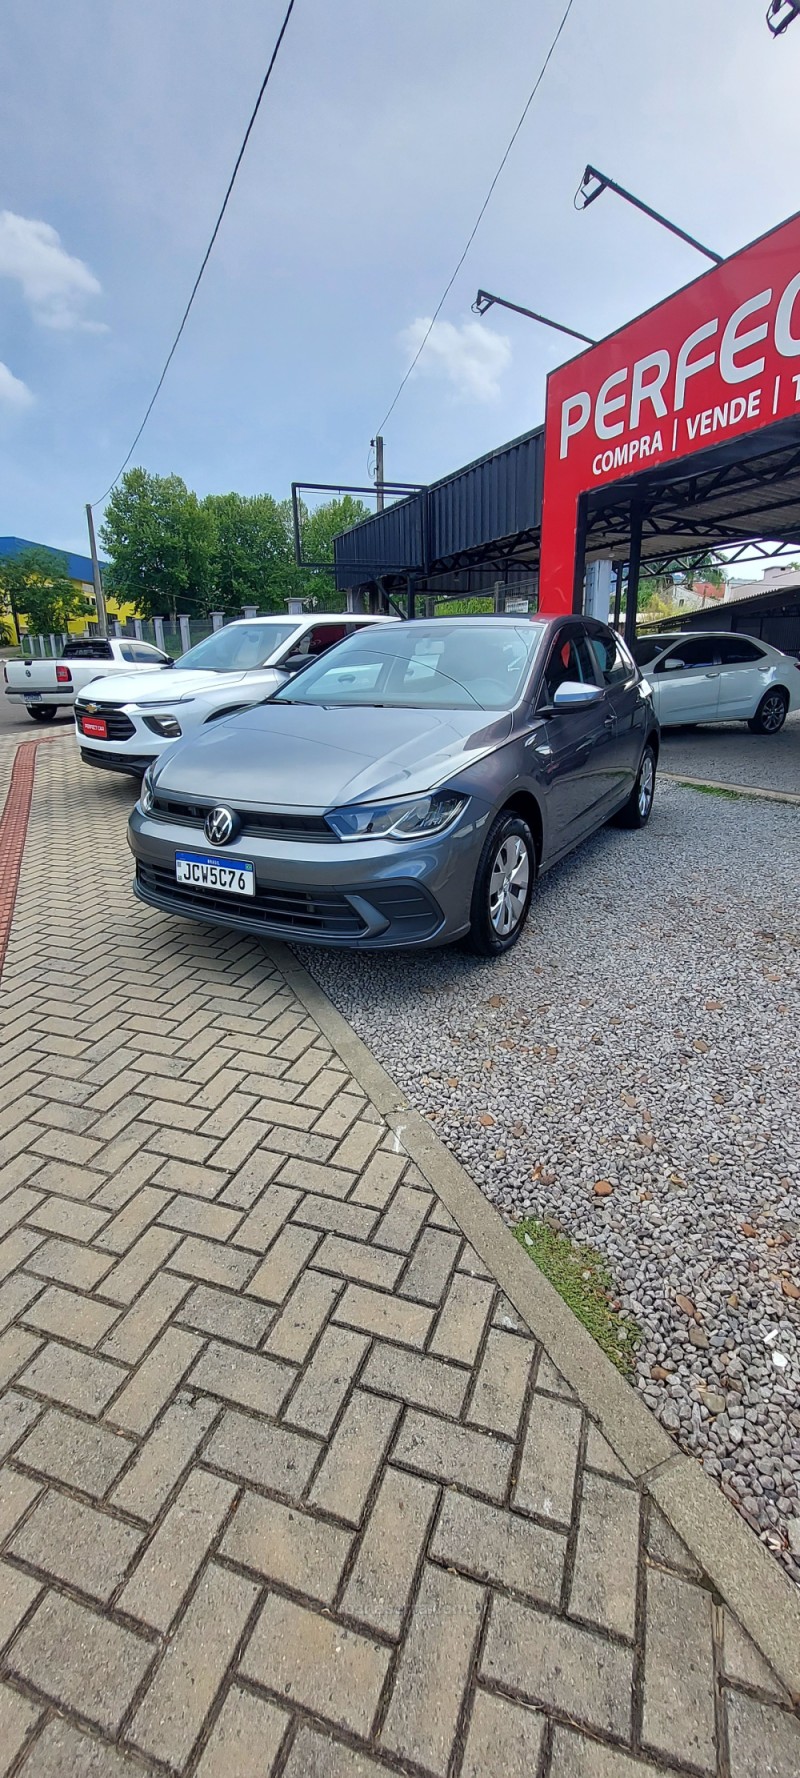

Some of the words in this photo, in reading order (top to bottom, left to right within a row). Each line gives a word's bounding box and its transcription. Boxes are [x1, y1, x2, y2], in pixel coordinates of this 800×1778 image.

[592, 431, 663, 475] COMPRA
[686, 388, 762, 440] VENDE
[183, 863, 246, 891] JCW5C76
